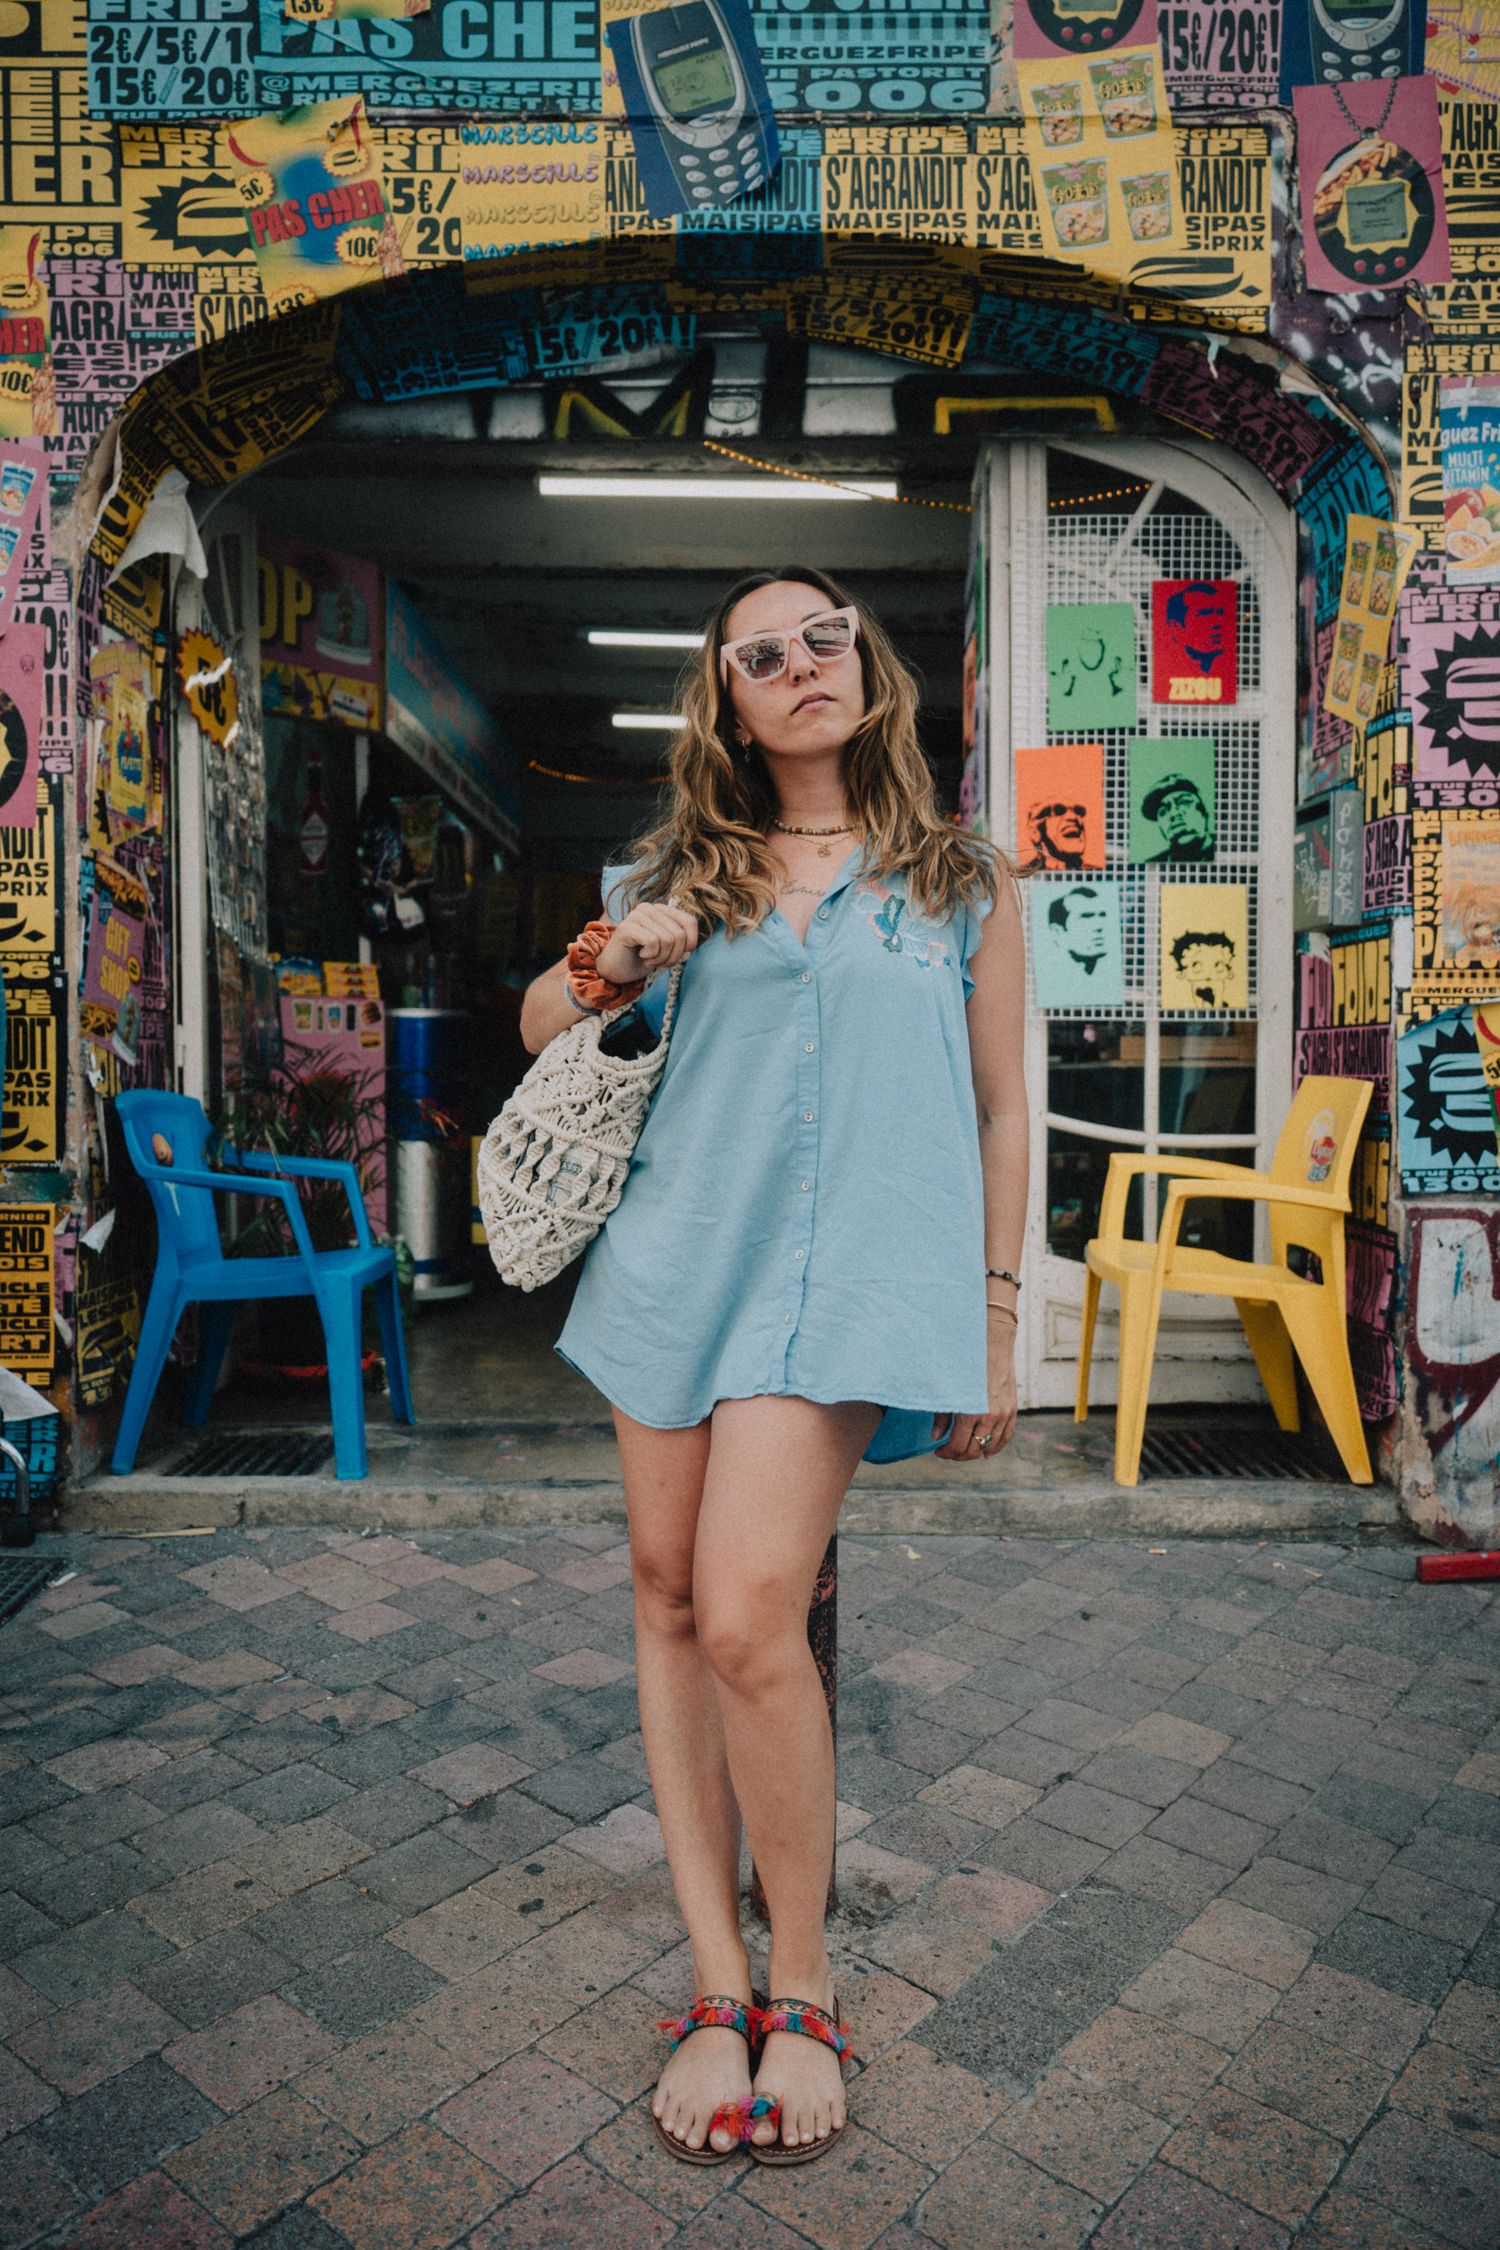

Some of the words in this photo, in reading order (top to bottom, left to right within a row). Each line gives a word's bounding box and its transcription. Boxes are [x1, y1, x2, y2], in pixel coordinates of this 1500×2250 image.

[91, 25, 253, 65] 2€/5€/1
[811, 67, 986, 80] PASTORET
[94, 66, 249, 106] 15€/20€
[261, 75, 602, 97] @MERGUEZFRI
[370, 92, 543, 111] PASTORET
[113, 111, 162, 120] RUE
[461, 122, 599, 146] MARSEILLE
[825, 137, 969, 154] FRIPE
[462, 162, 599, 185] MARSEILLE
[826, 156, 968, 211] S'AGRANDIT
[240, 178, 264, 203] 5€
[250, 199, 307, 248] PAS
[307, 179, 385, 230] CHER
[464, 202, 601, 225] MARSEILLE
[681, 213, 758, 231] MAIS
[768, 213, 822, 231] PAS
[826, 212, 903, 230] MAIS
[913, 212, 967, 229] PAS
[1213, 216, 1266, 231] PAS
[346, 236, 378, 258] 10€
[1213, 235, 1265, 251] PRIX
[147, 263, 195, 273] RUE
[1128, 304, 1267, 334] 13006
[1, 371, 33, 394] 10€
[1168, 676, 1222, 701] ZIZOU
[1331, 938, 1391, 1027] FRIPE
[1486, 1060, 1500, 1080] 5
